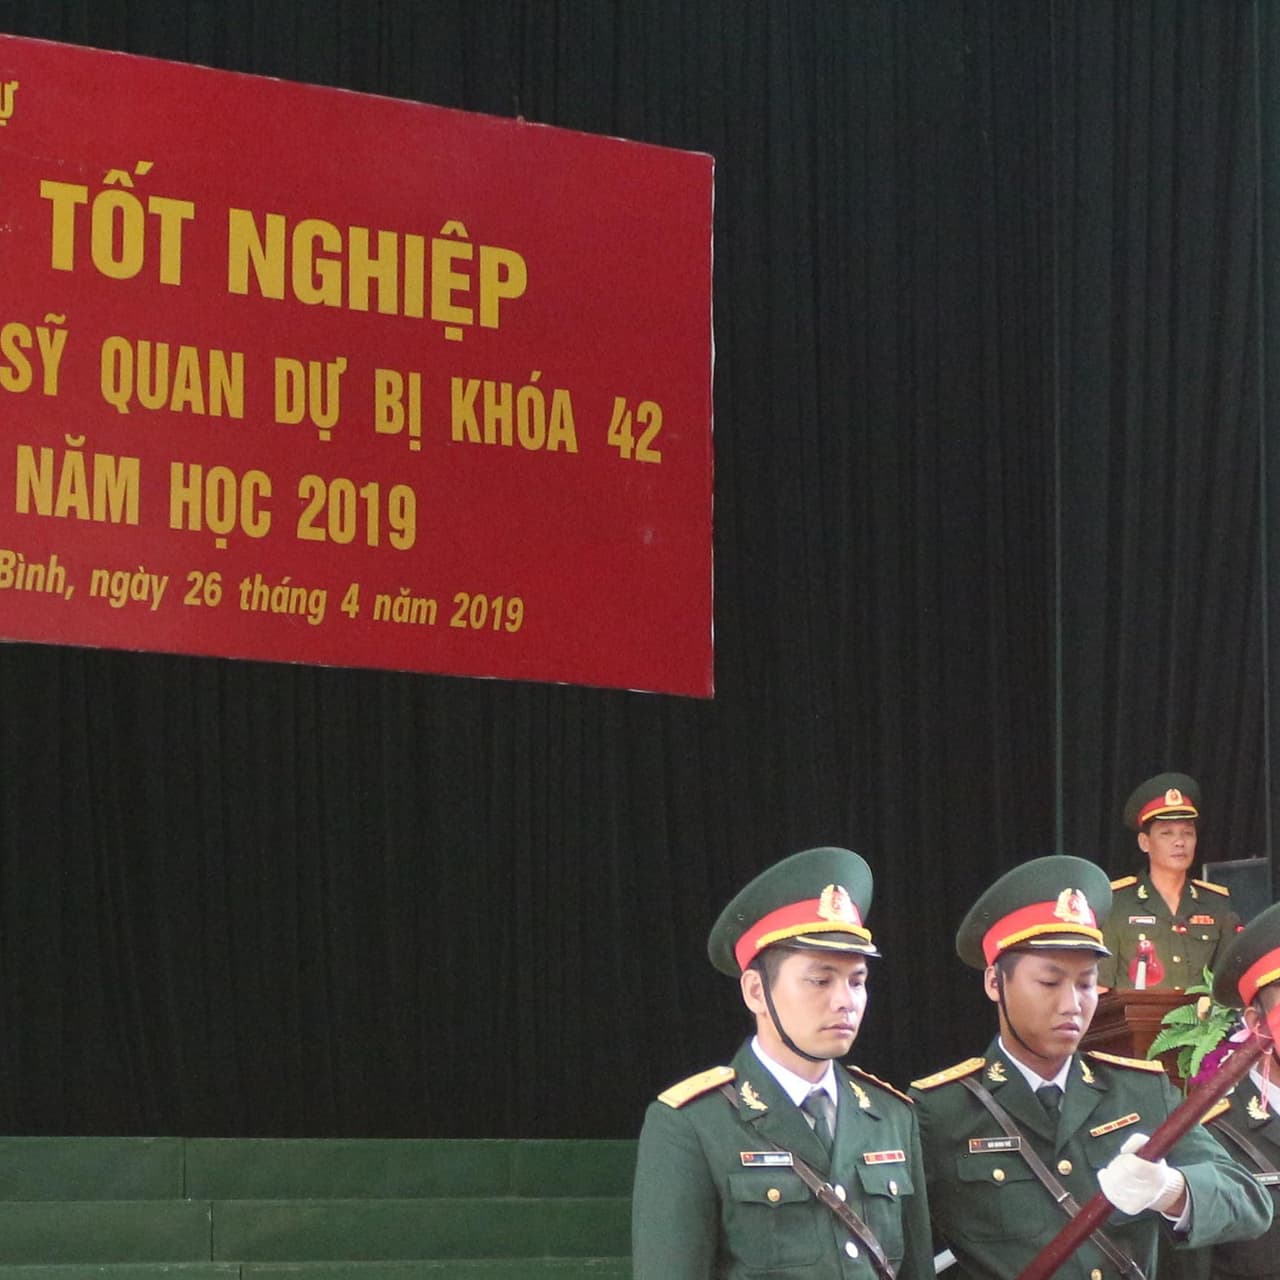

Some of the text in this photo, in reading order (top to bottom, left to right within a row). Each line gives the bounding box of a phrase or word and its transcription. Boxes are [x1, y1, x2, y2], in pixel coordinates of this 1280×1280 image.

[39, 160, 195, 286] TỐT
[228, 207, 528, 342] NGHIỆP
[100, 335, 244, 419] QUAN
[274, 356, 348, 442] DỰ
[374, 368, 422, 451] BỊ
[451, 370, 578, 453] KHÓA
[607, 396, 663, 464] 42
[15, 433, 417, 550] NĂM HỌC 2019
[89, 565, 169, 612] ngày
[183, 570, 223, 607] 26
[239, 573, 327, 626] tháng
[340, 583, 360, 619] 4
[373, 587, 438, 625] năm
[450, 592, 524, 633] 2019
